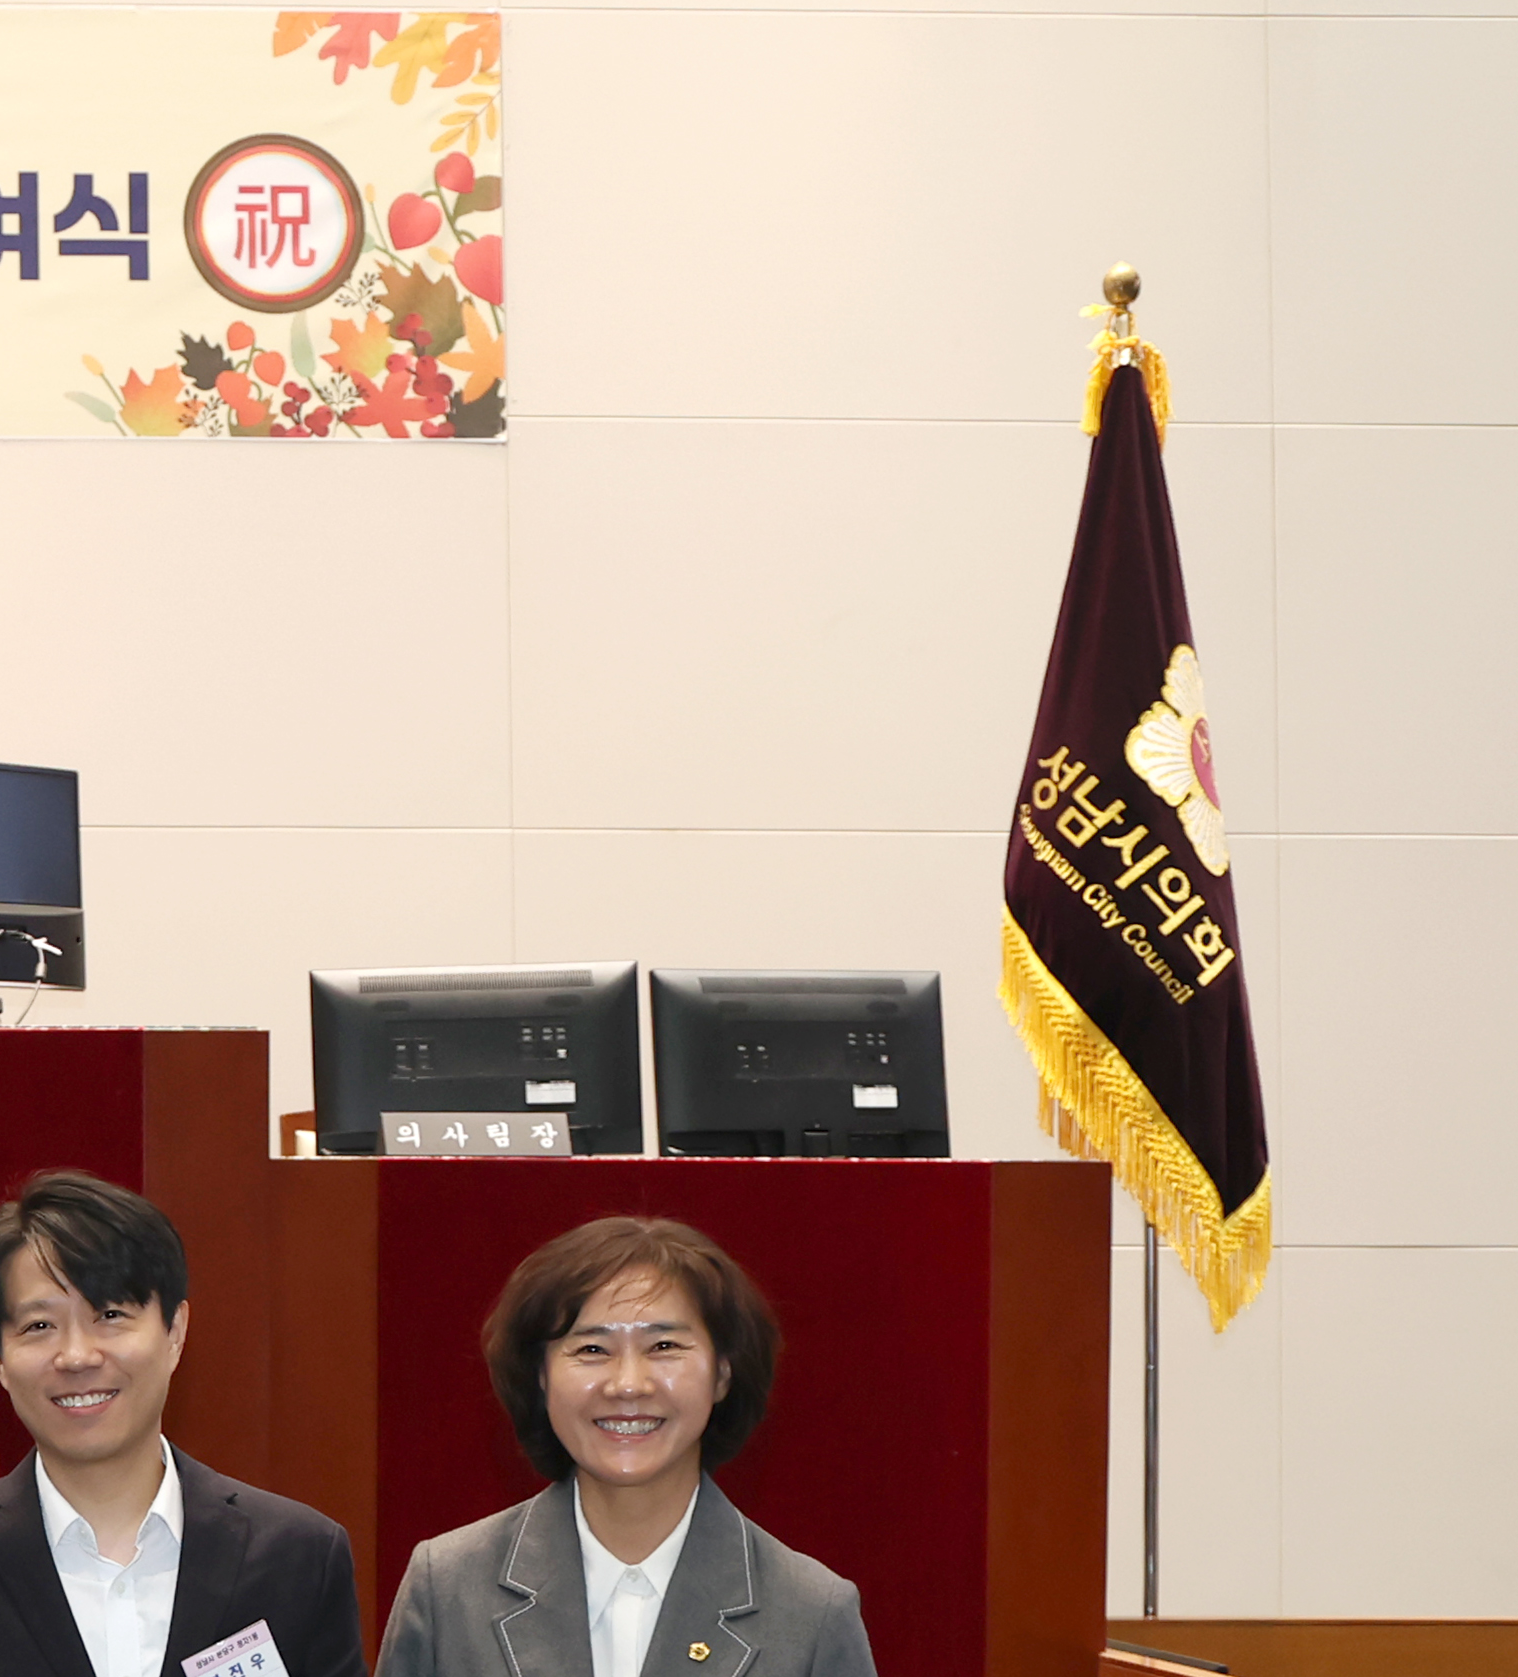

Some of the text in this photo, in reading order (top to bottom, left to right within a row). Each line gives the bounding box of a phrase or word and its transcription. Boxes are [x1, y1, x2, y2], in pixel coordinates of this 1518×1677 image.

[232, 184, 316, 270] 祝
[1031, 744, 1237, 988] 성남시의회
[1082, 883, 1127, 929] City
[1121, 923, 1195, 1005] Council
